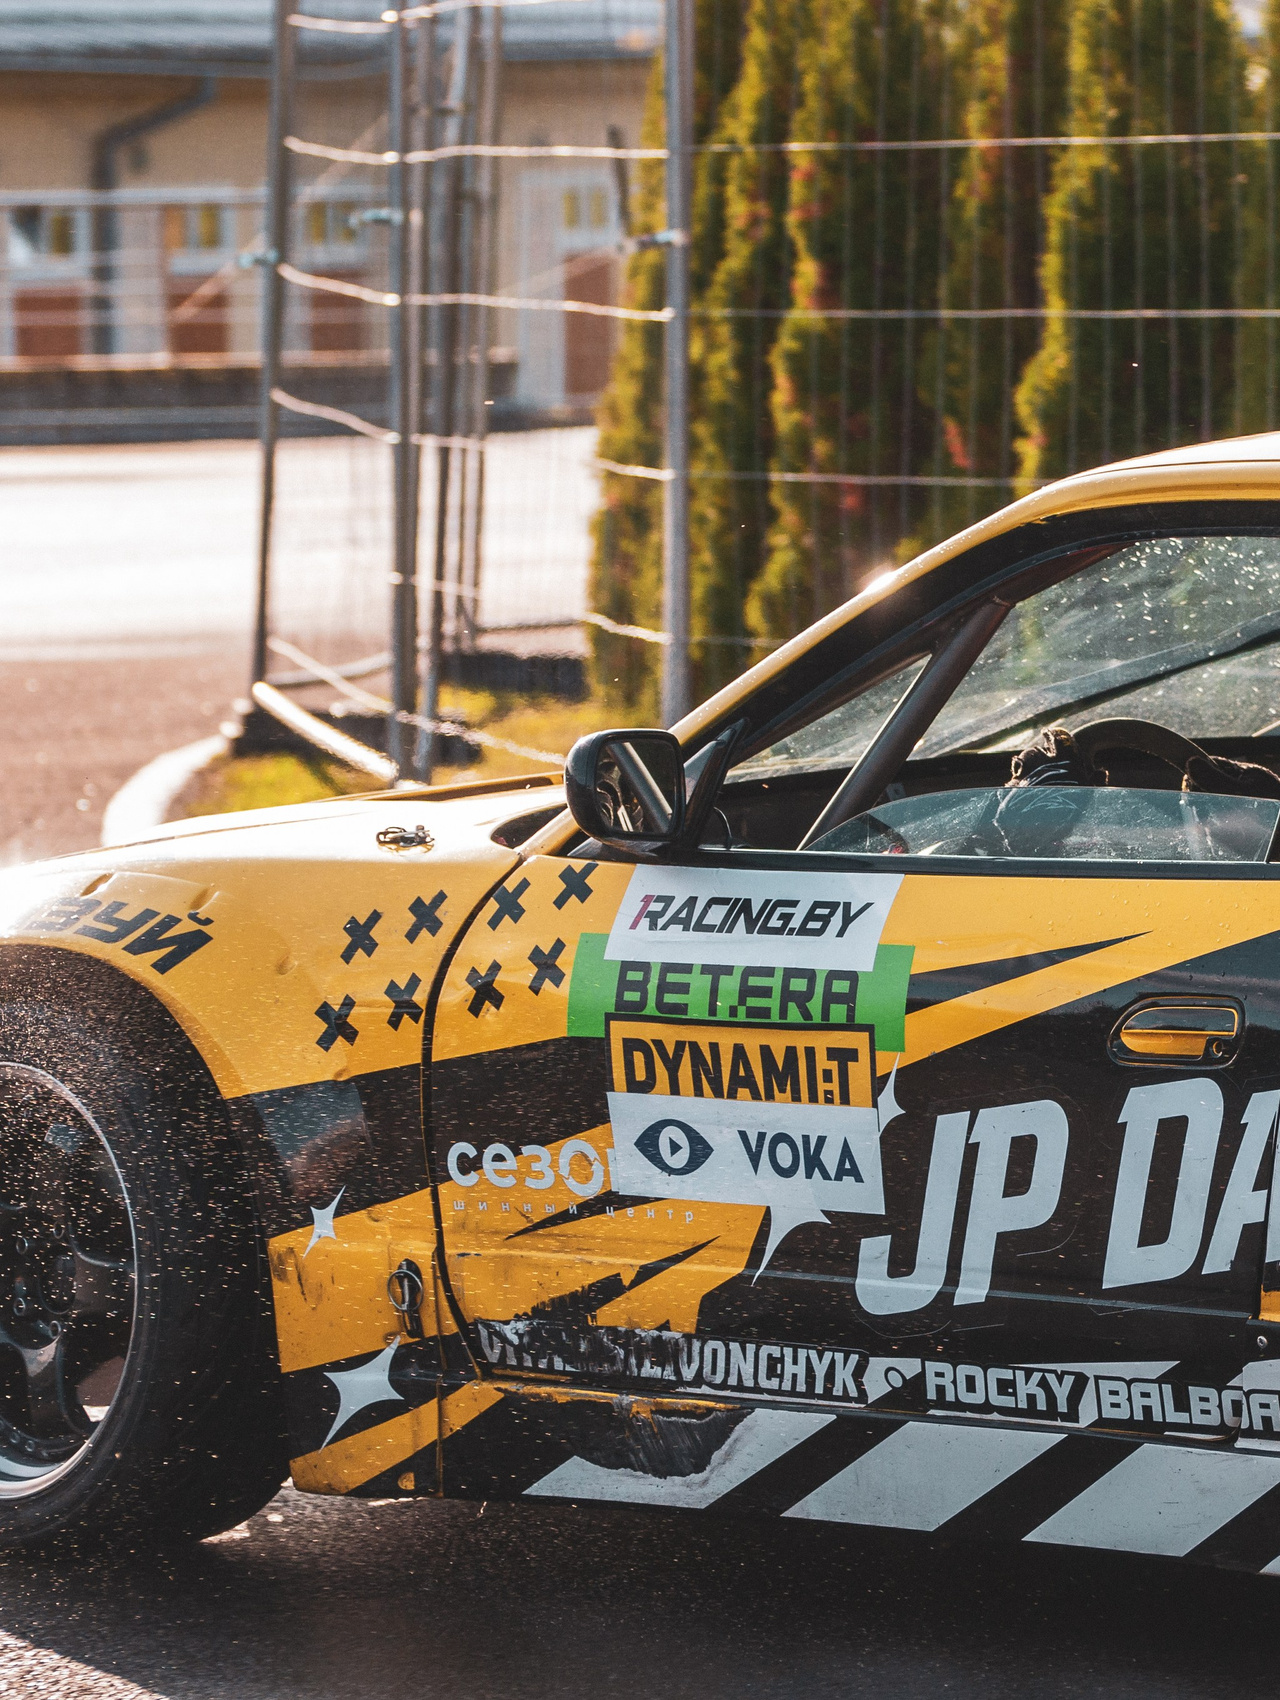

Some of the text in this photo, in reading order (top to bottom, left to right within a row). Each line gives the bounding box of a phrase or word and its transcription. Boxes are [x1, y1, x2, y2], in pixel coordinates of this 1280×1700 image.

[737, 1130, 865, 1183] VOKA
[605, 1205, 694, 1223] центр
[855, 1099, 1069, 1316] JP
[925, 1361, 1076, 1411] ROCKY
